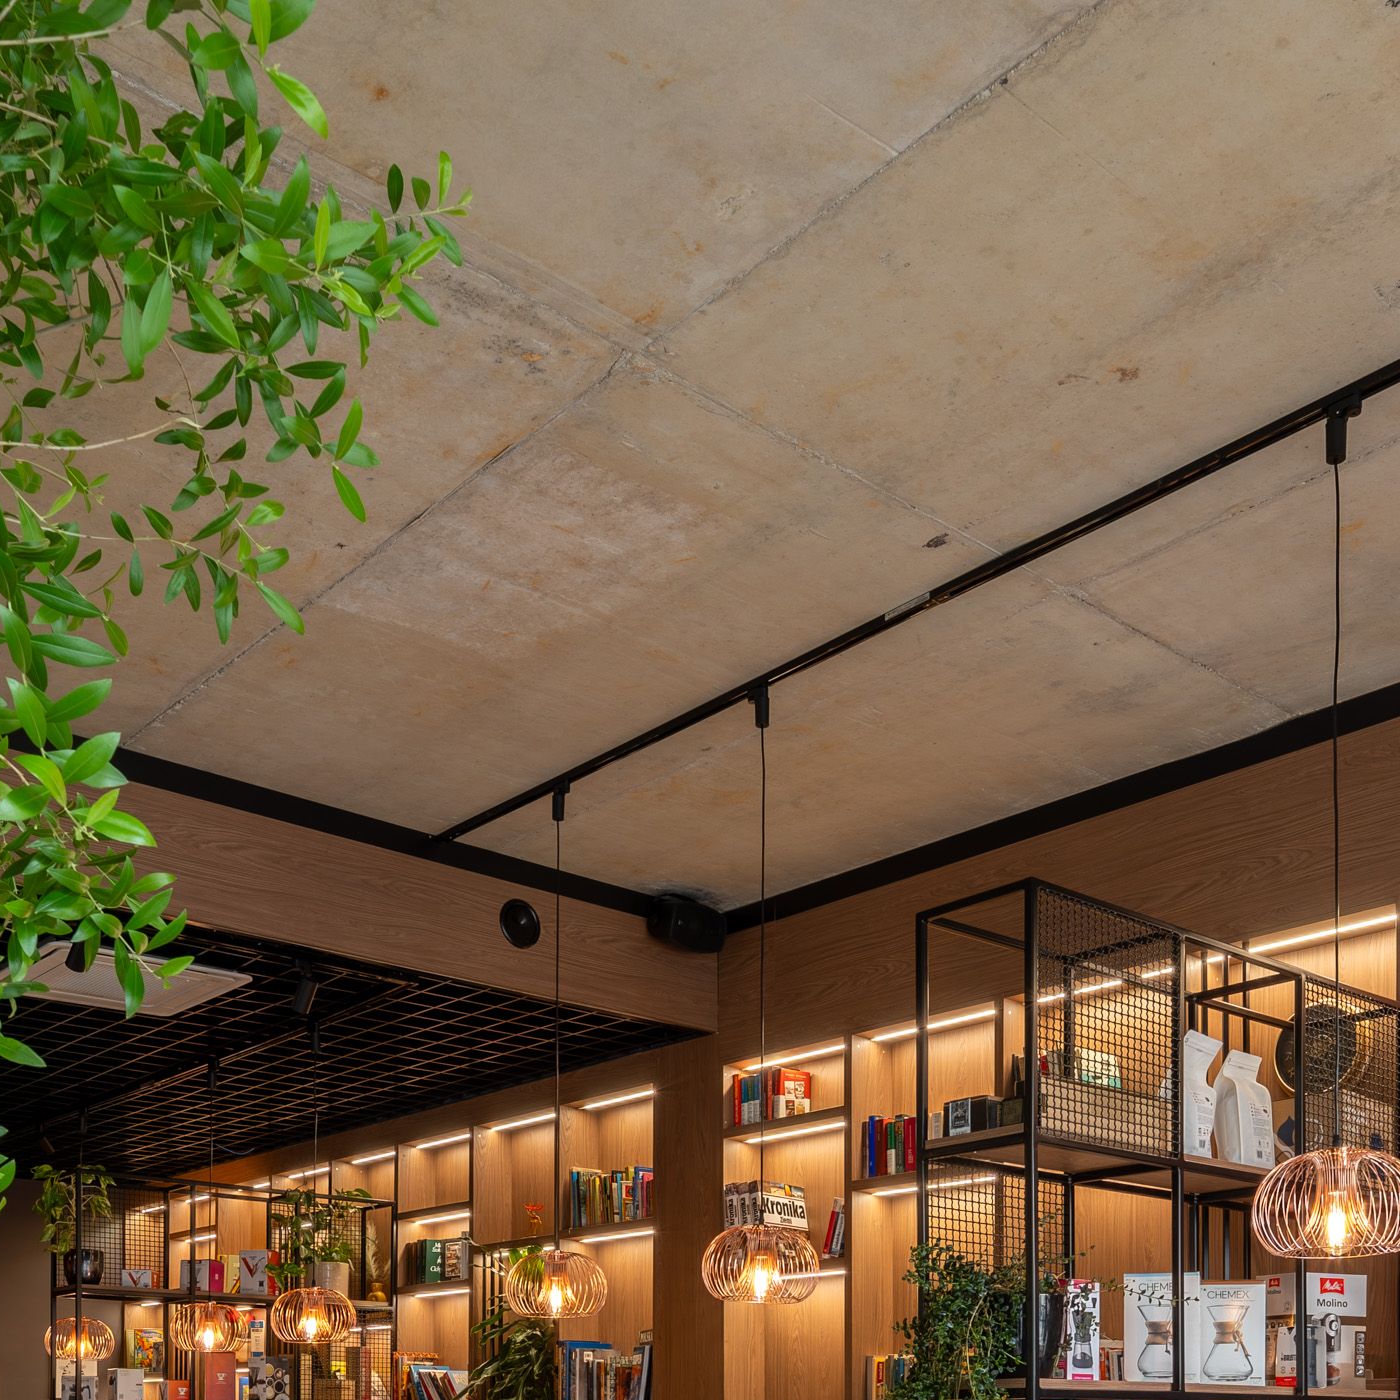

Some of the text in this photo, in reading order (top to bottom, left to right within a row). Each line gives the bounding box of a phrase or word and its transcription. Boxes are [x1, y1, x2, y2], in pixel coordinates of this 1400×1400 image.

[763, 1197, 806, 1219] Kronika
[1138, 1282, 1172, 1292] CHEME
[1321, 1279, 1342, 1291] Melitta
[1207, 1290, 1250, 1300] CHEMEX
[1316, 1298, 1348, 1308] Molino
